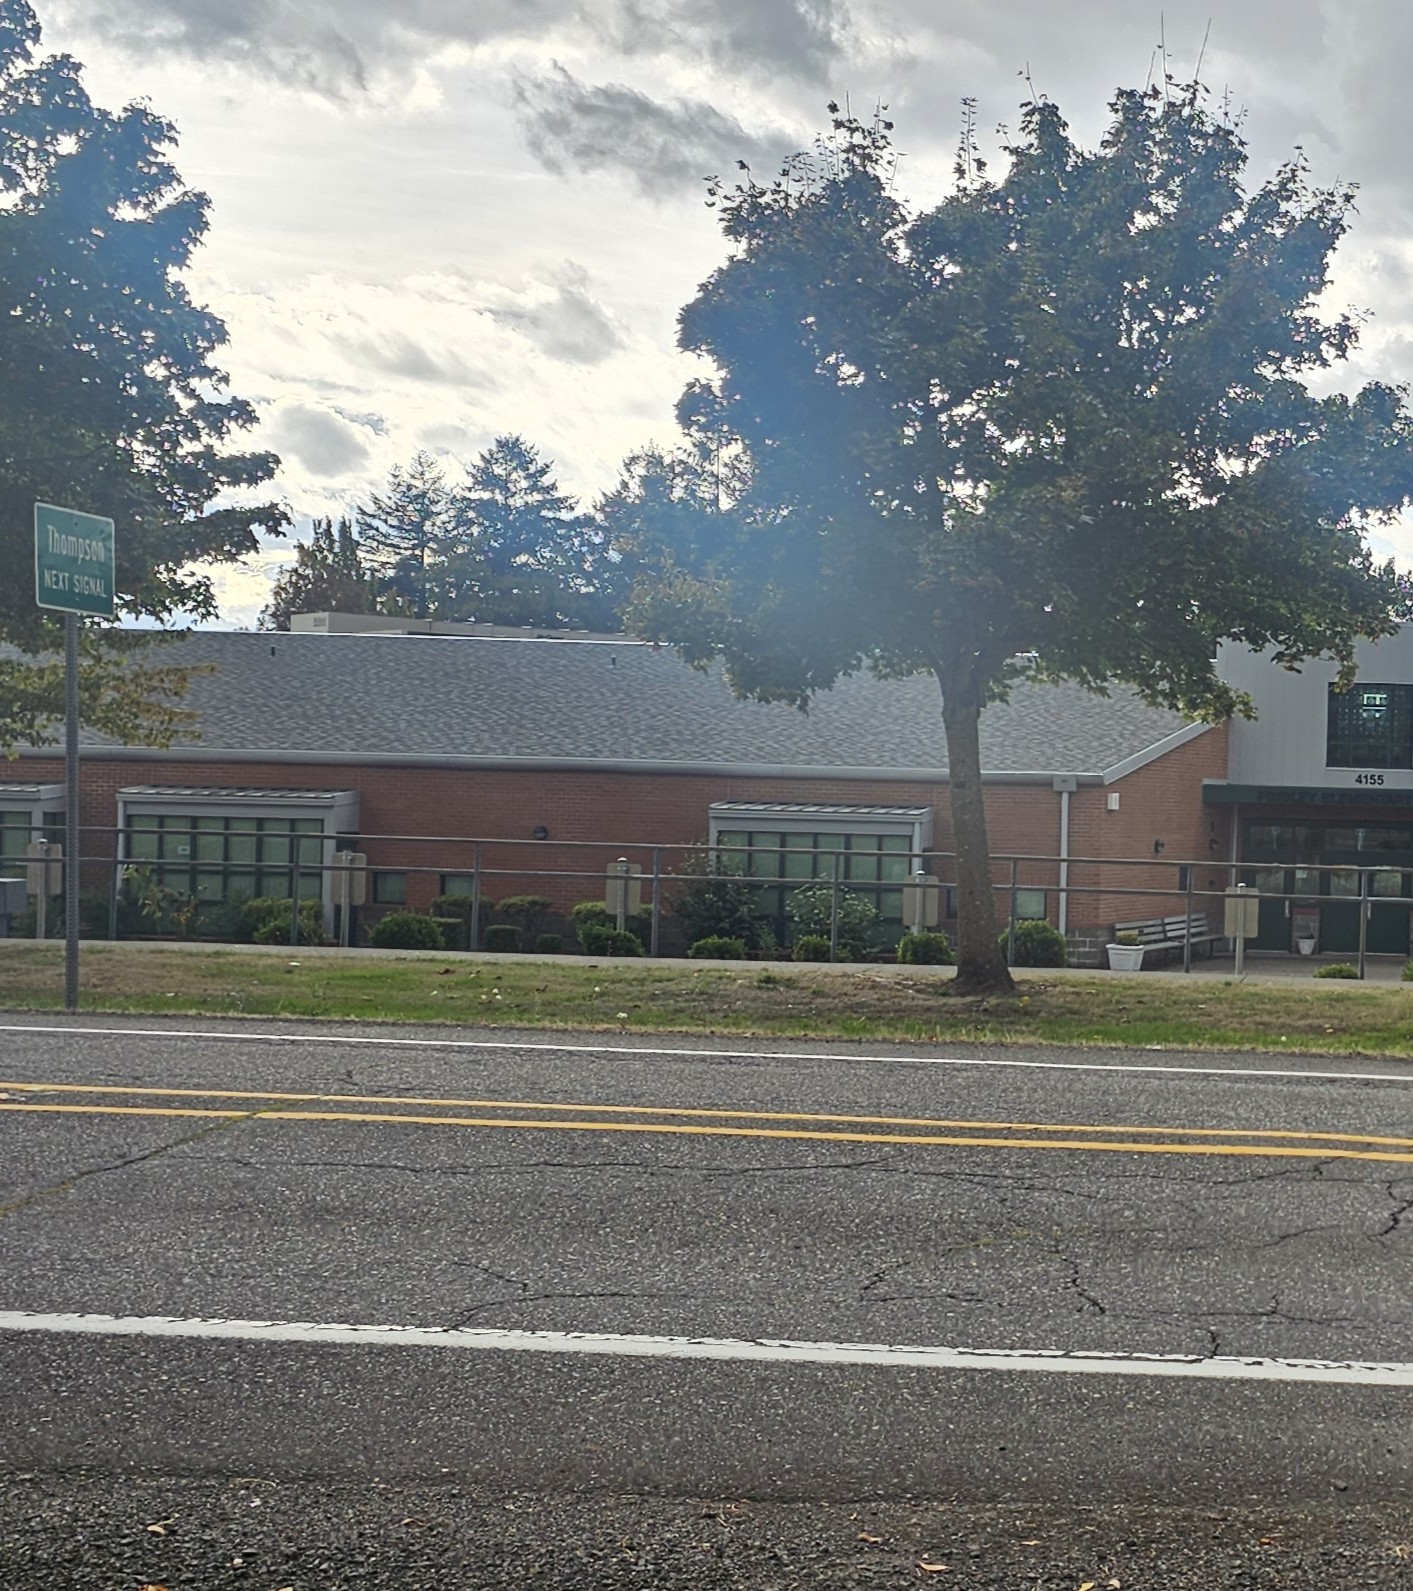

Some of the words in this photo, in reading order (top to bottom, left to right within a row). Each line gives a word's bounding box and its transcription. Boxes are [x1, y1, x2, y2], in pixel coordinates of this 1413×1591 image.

[47, 525, 104, 565] Thompson
[44, 569, 70, 591] NEXT
[73, 574, 107, 598] SIGNAL
[1355, 774, 1384, 786] 4155
